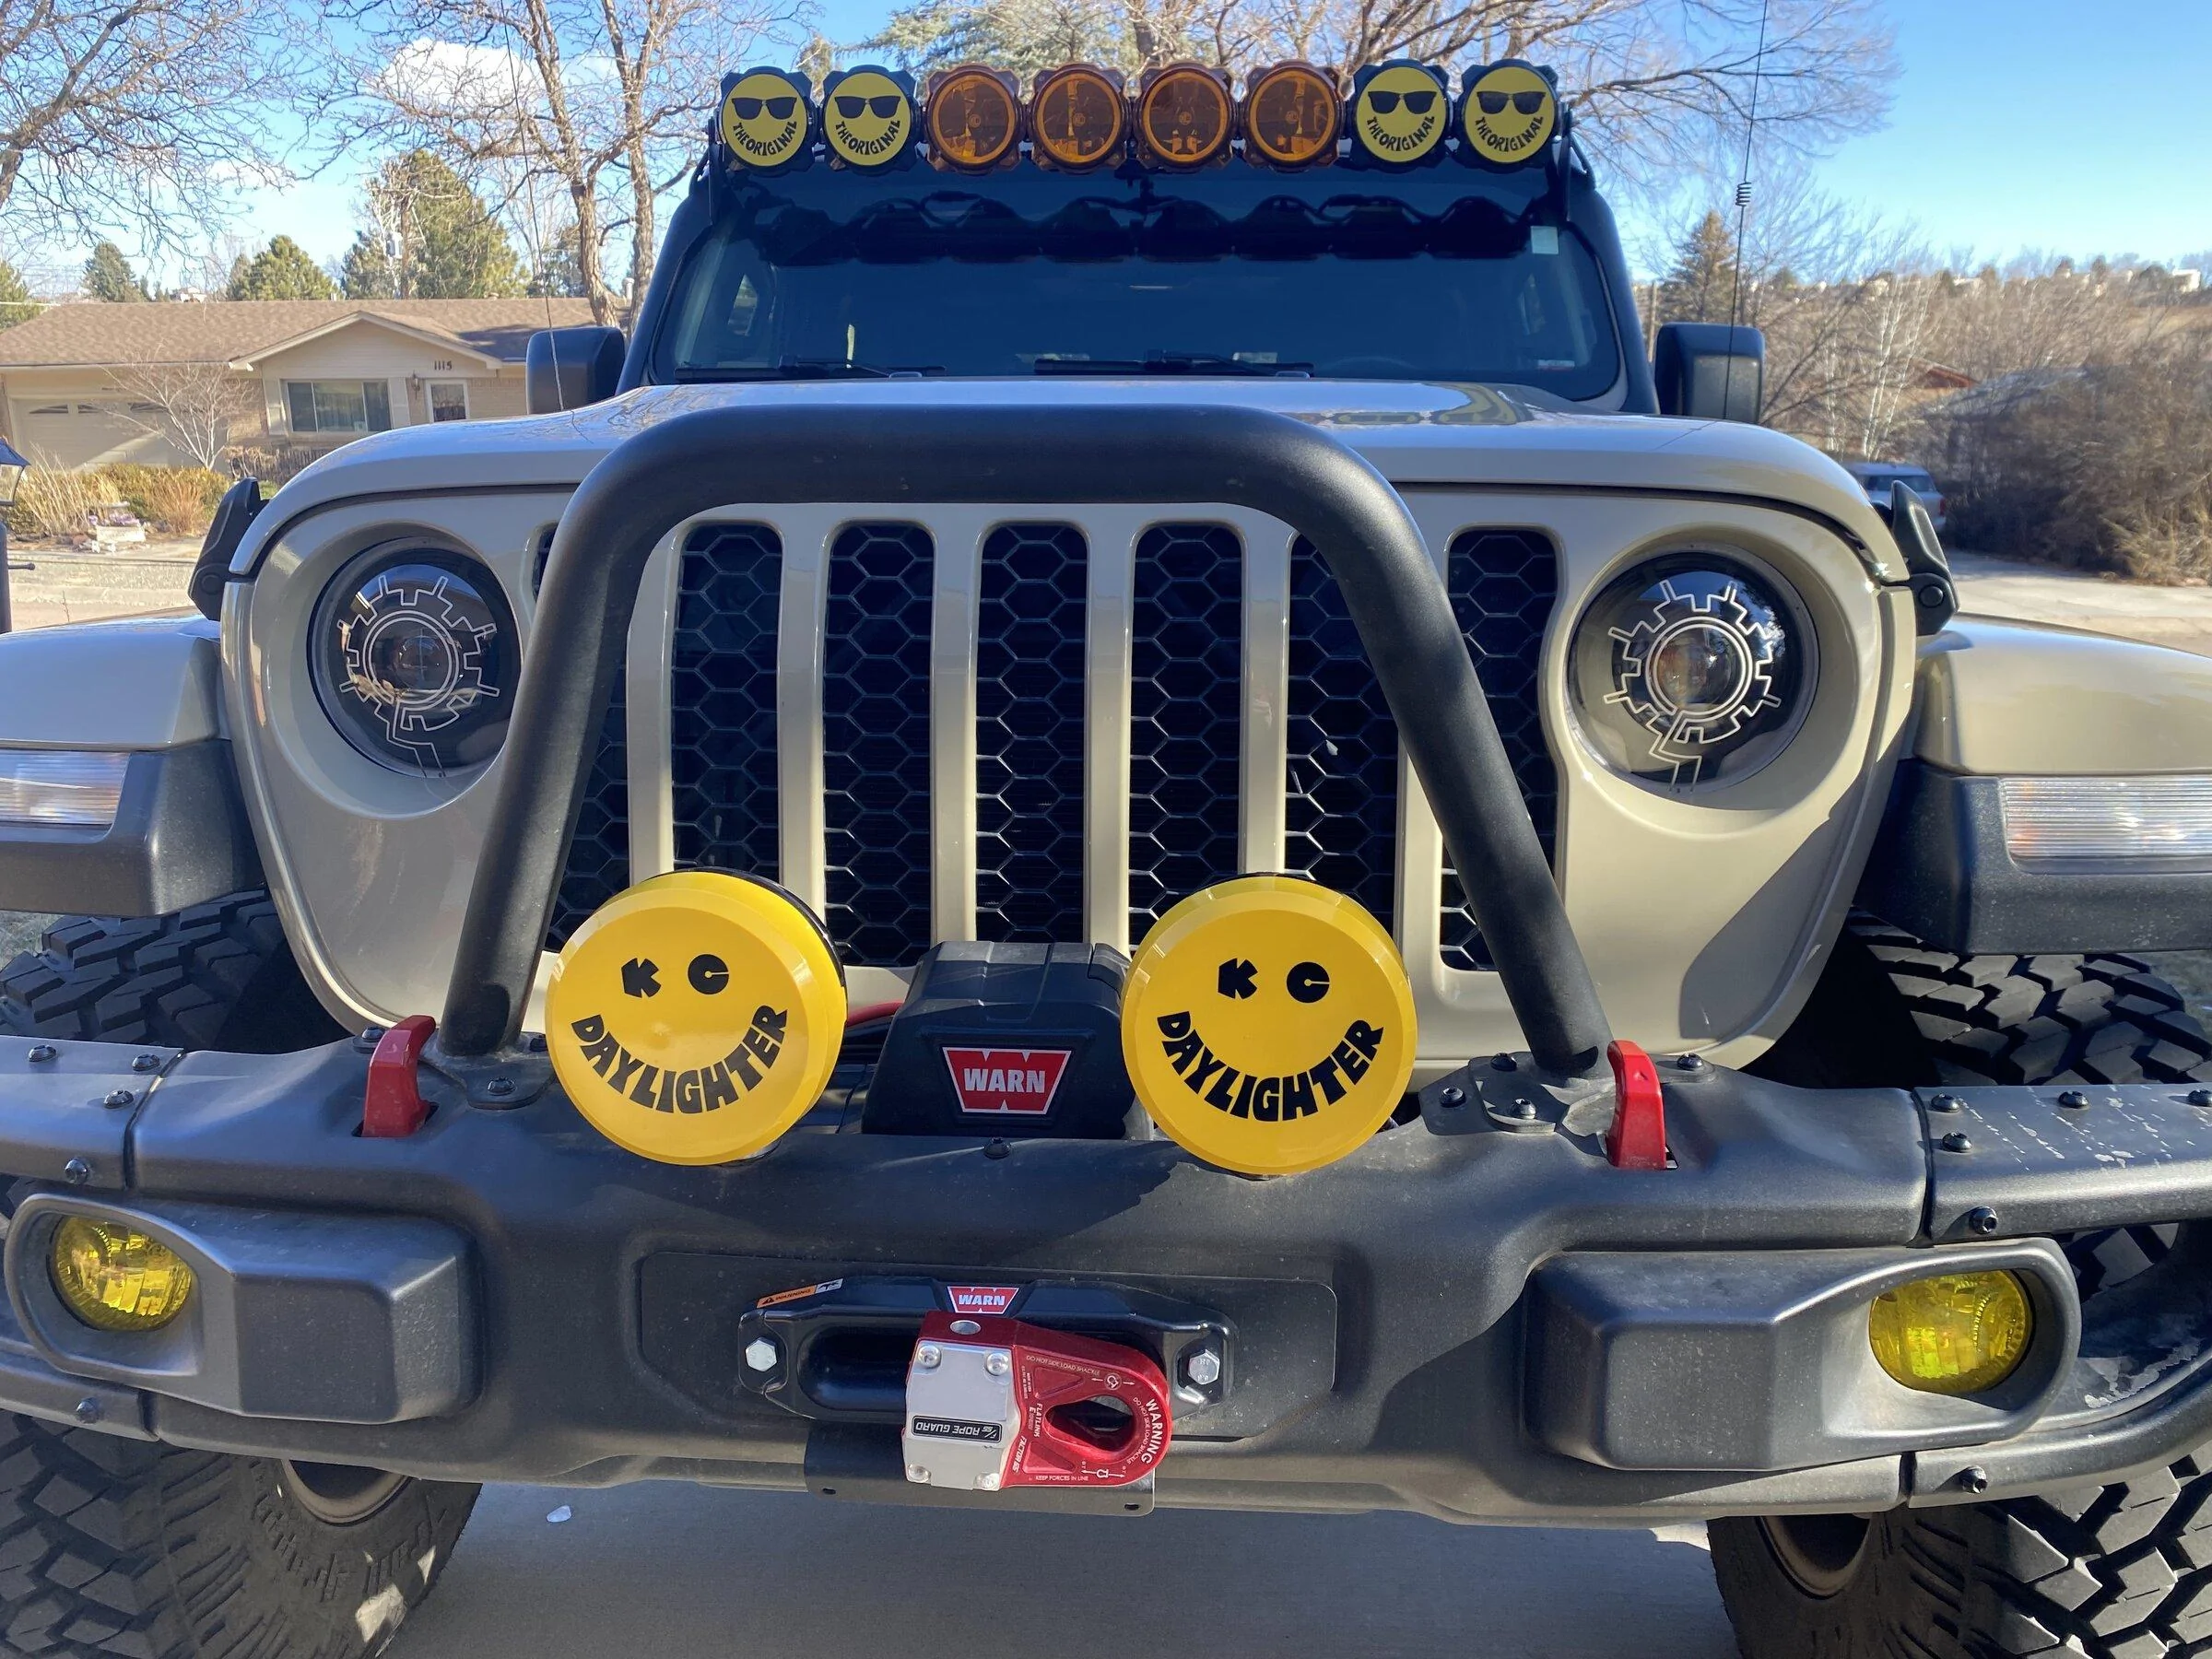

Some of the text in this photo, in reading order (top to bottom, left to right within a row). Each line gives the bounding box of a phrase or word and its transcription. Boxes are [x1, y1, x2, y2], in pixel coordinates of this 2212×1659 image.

[571, 1005, 788, 1114] DAYLIGHTER
[1156, 1010, 1384, 1123] DAYLIGHTER
[963, 1067, 1046, 1094] WARN
[959, 1294, 1006, 1306] WARN
[915, 1421, 951, 1433] GUARD
[951, 1425, 981, 1436] ROPE
[1033, 1403, 1043, 1438] FLATLINK
[1141, 1398, 1163, 1465] WARNING
